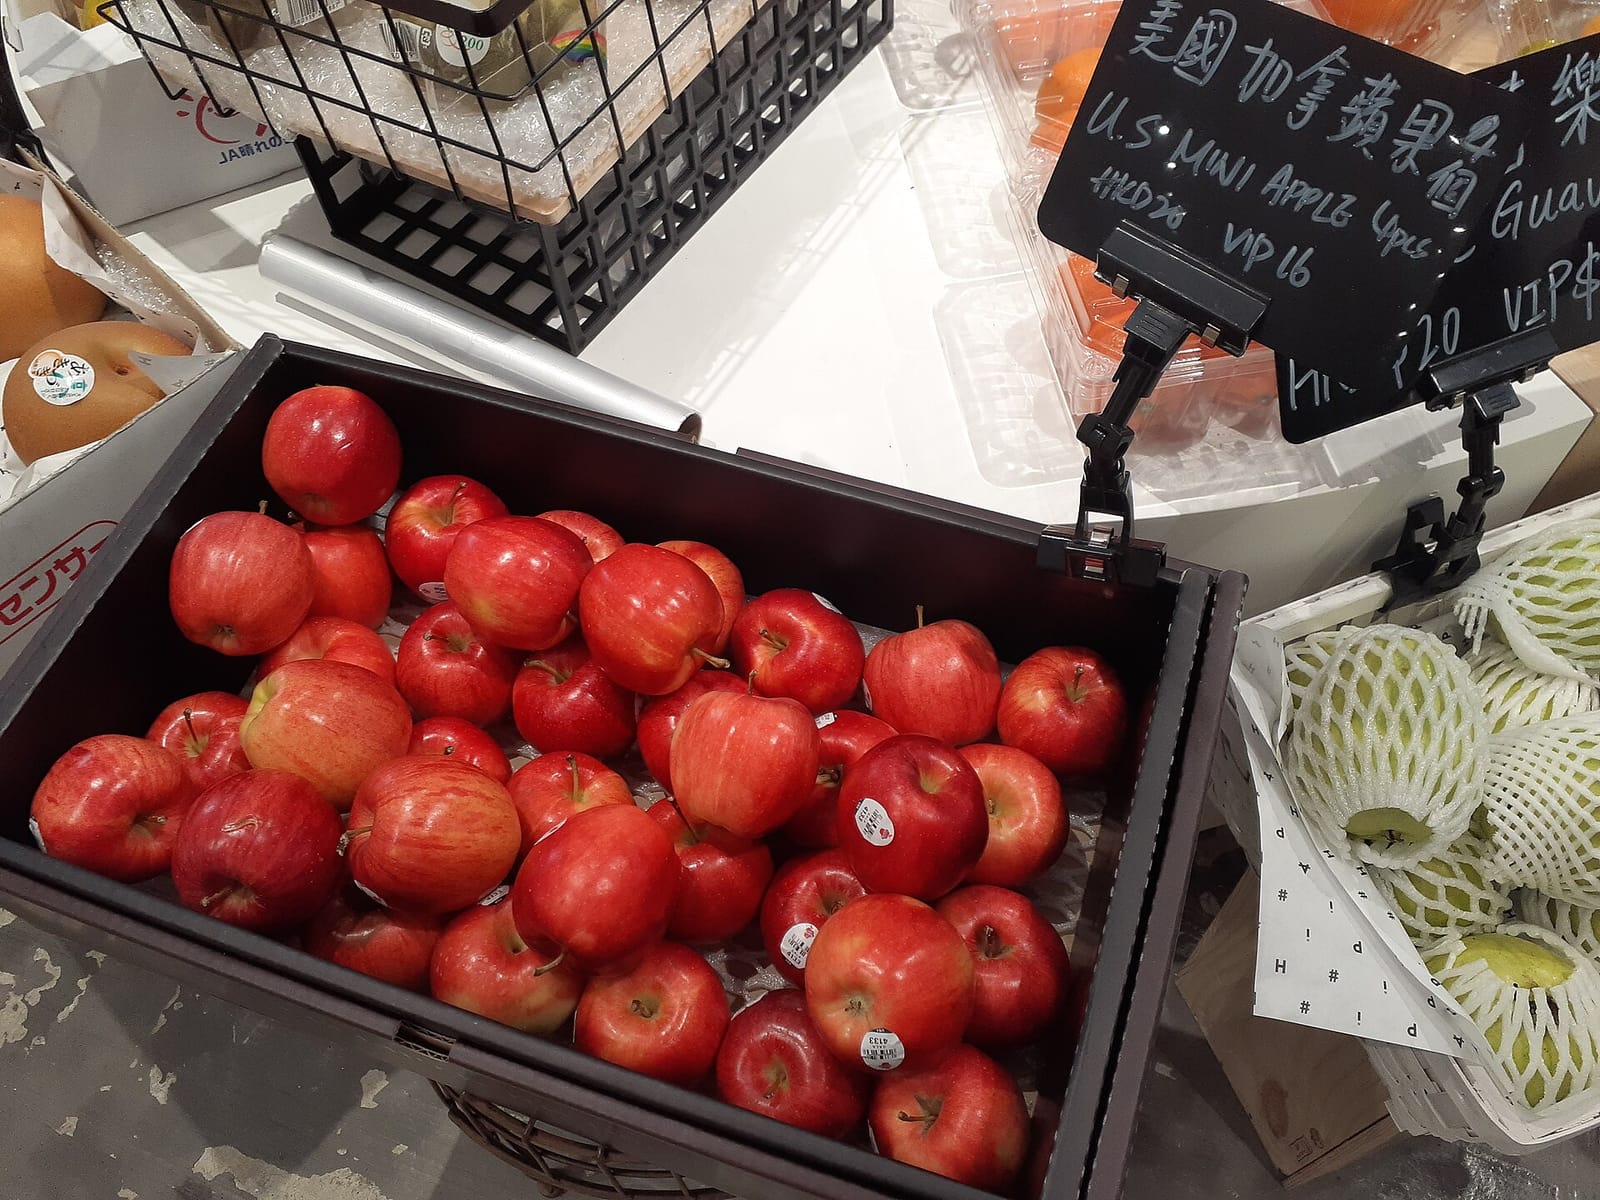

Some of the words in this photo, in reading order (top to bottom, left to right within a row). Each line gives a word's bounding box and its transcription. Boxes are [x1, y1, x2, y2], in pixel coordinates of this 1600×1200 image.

[219, 136, 296, 164] JA晴れの
[1169, 128, 1256, 192] MINI
[1261, 164, 1357, 228] APPLE
[1224, 223, 1275, 273] VIP
